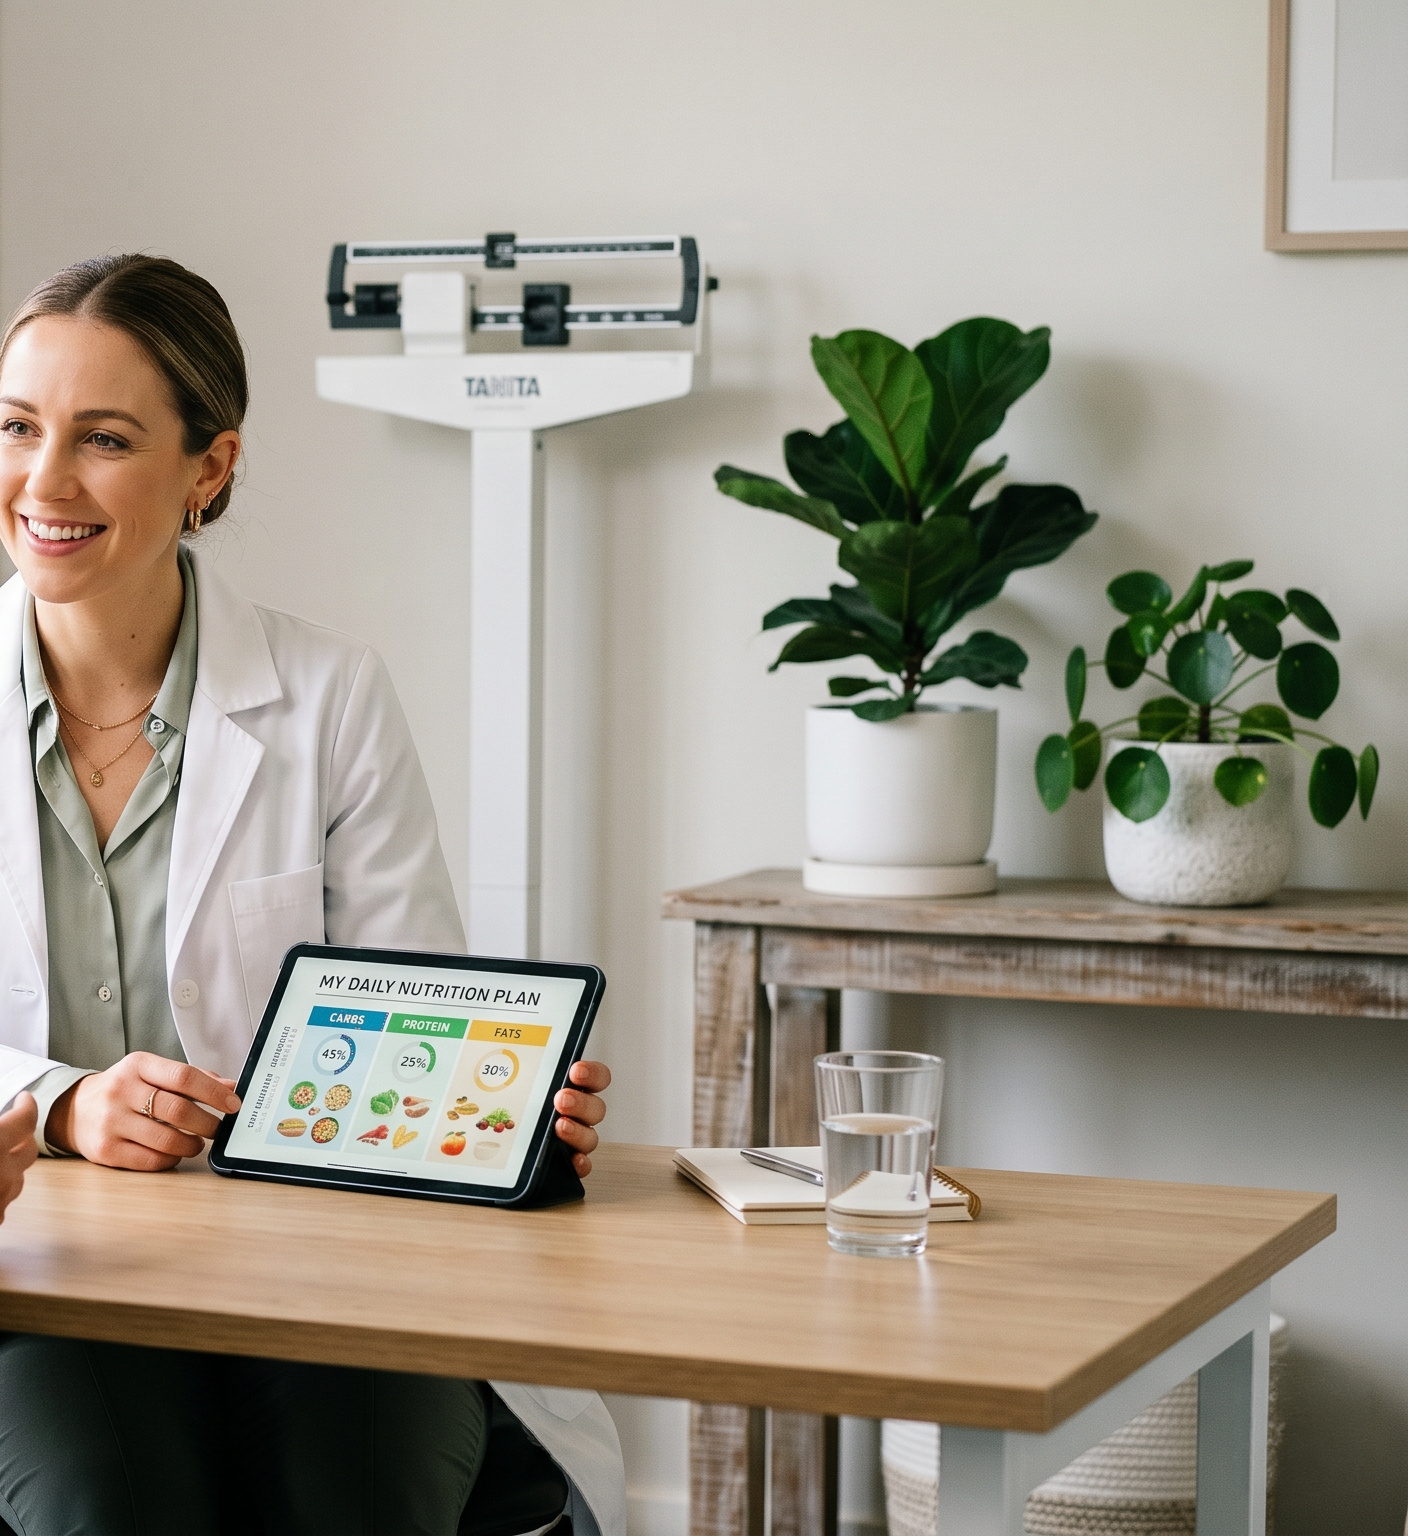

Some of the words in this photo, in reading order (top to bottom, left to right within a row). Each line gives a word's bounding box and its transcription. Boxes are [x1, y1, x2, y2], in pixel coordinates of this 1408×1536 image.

[319, 975, 346, 990] MY
[348, 977, 395, 994] DAILY
[397, 981, 490, 1003] NUTRITION
[493, 989, 541, 1007] PLAN
[329, 1012, 366, 1026] CARBS
[402, 1019, 451, 1034] PROTEIN
[494, 1027, 522, 1040] FATS
[321, 1048, 347, 1061] 45%
[400, 1056, 427, 1070] 25%
[481, 1064, 509, 1078] 30%
